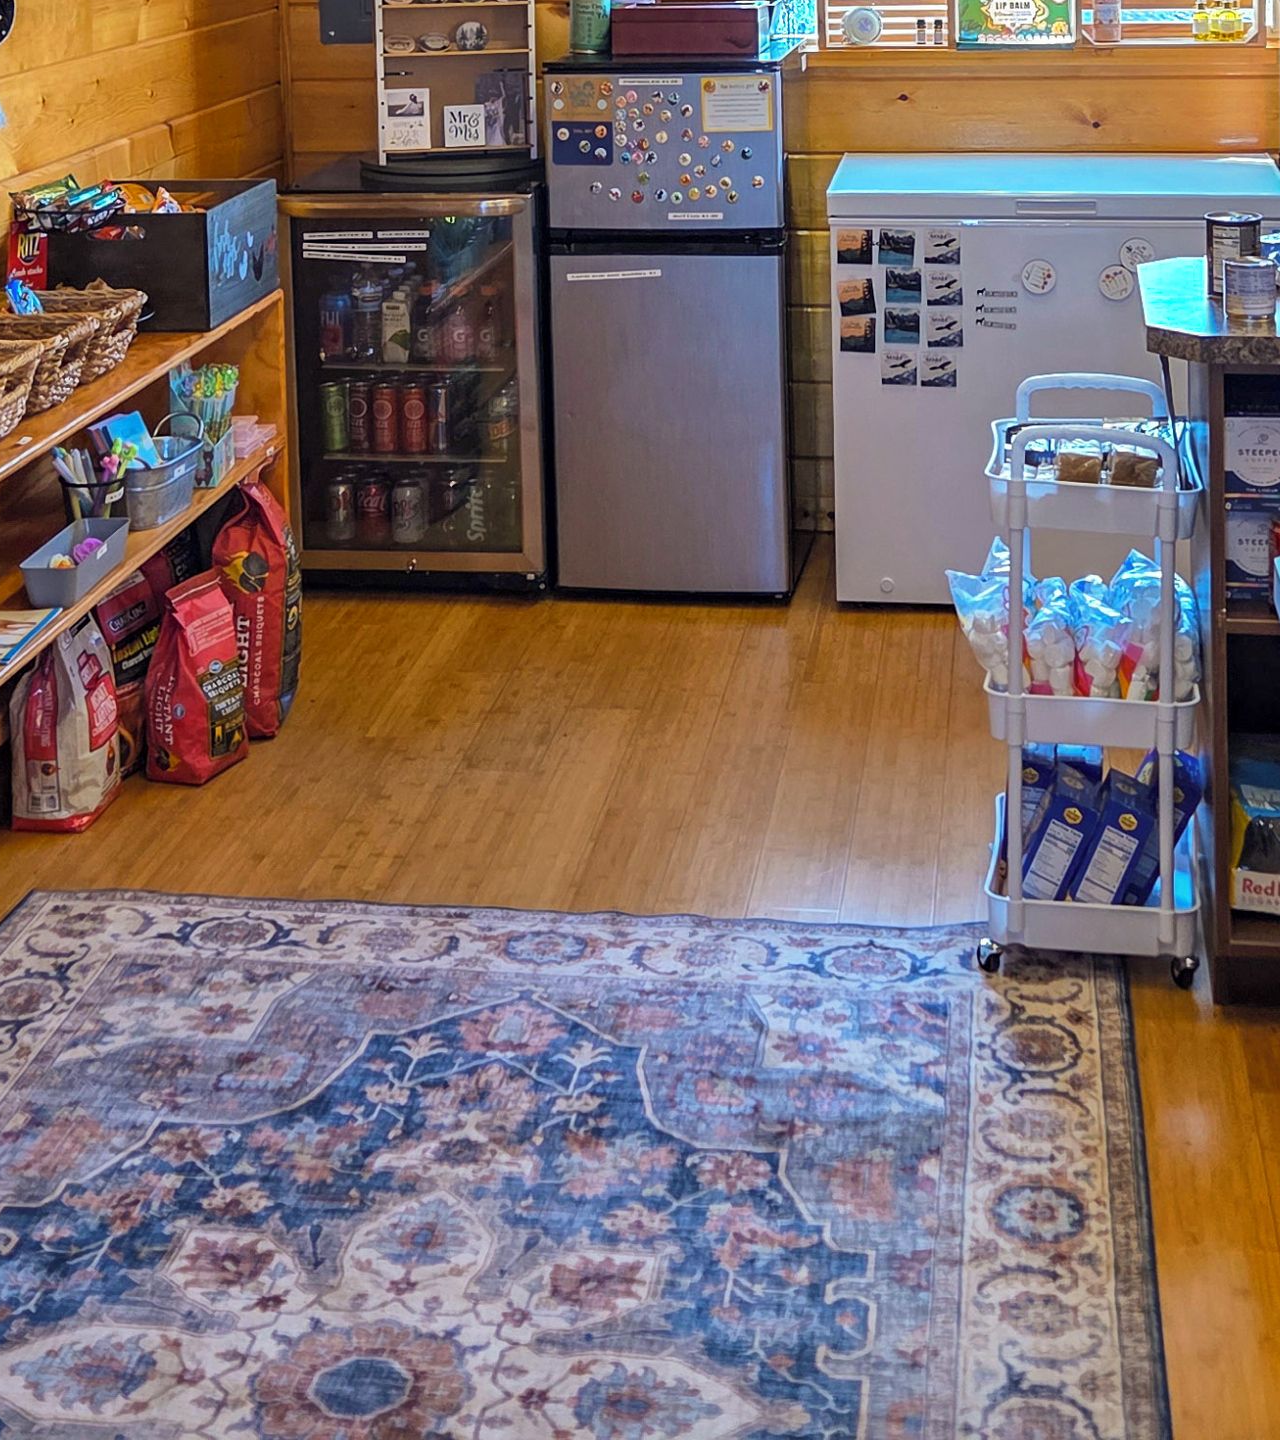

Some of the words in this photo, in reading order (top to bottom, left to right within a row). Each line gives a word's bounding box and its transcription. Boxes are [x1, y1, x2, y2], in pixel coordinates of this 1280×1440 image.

[995, 2, 1007, 10] LIP
[1009, 2, 1031, 10] BALM
[449, 110, 469, 124] Mr
[468, 111, 482, 126] &
[448, 124, 480, 142] Mrs
[16, 233, 40, 258] RITZ
[453, 329, 466, 343] G
[466, 488, 484, 542] Sprite
[255, 595, 265, 647] BRIQUETS
[202, 670, 240, 693] CHARCOAL
[253, 649, 262, 705] CHARCOAL
[207, 678, 242, 698] BRIQUETS
[1242, 877, 1275, 897] Red
